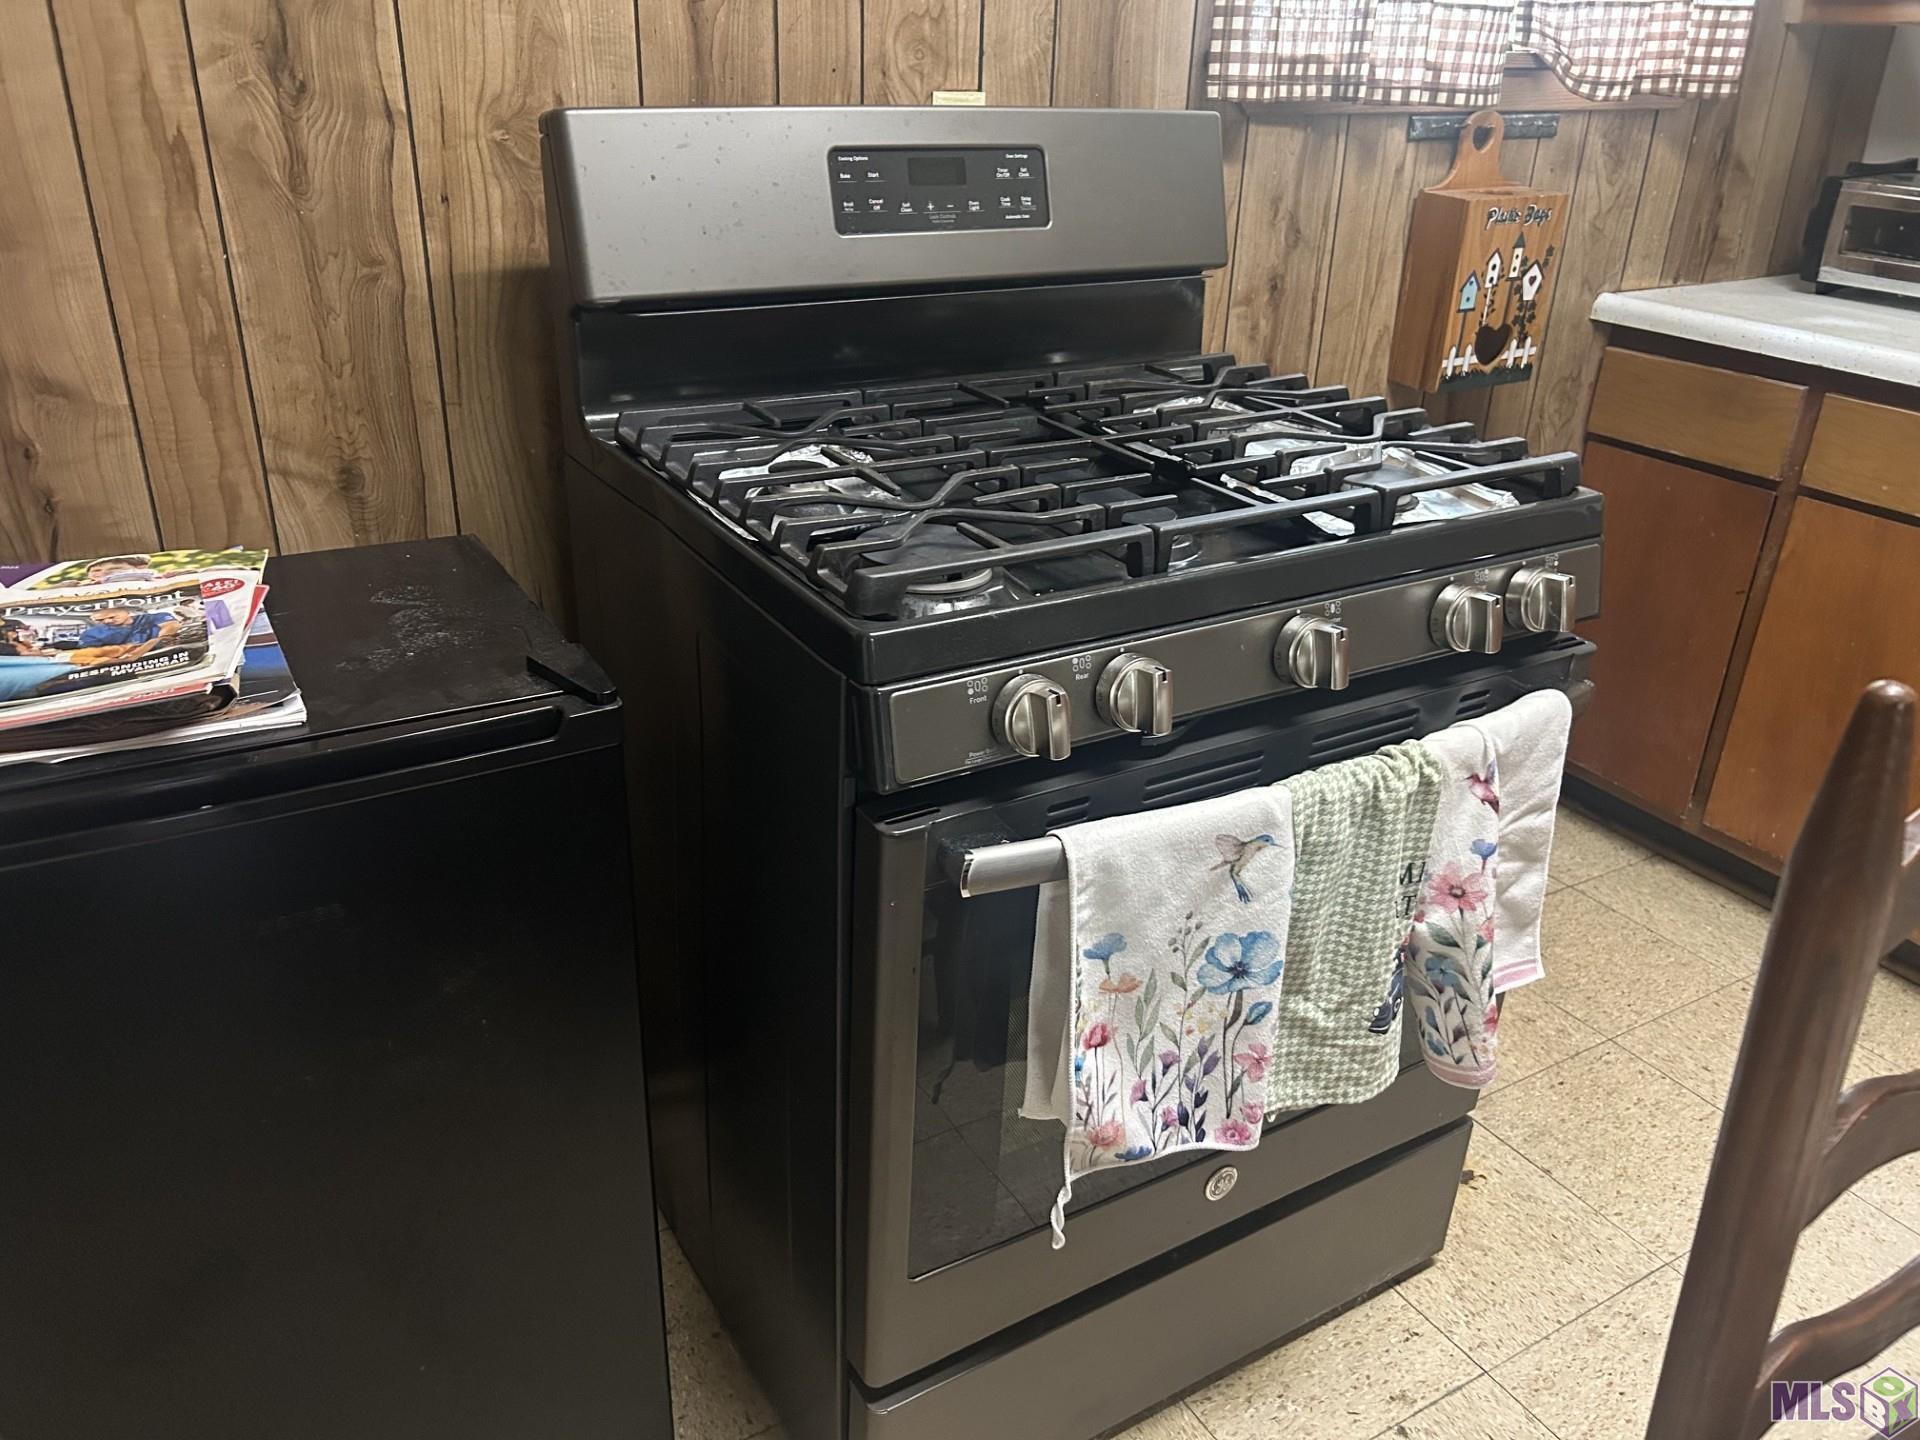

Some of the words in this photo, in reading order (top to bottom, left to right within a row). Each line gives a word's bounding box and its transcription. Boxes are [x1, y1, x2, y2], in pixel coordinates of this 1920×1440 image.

[4, 590, 186, 617] PrayerPoint
[68, 656, 169, 680] RESPONDING
[173, 651, 189, 659] IN
[111, 656, 190, 677] MYANMAR
[1075, 673, 1090, 681] Rear
[969, 695, 988, 705] Front
